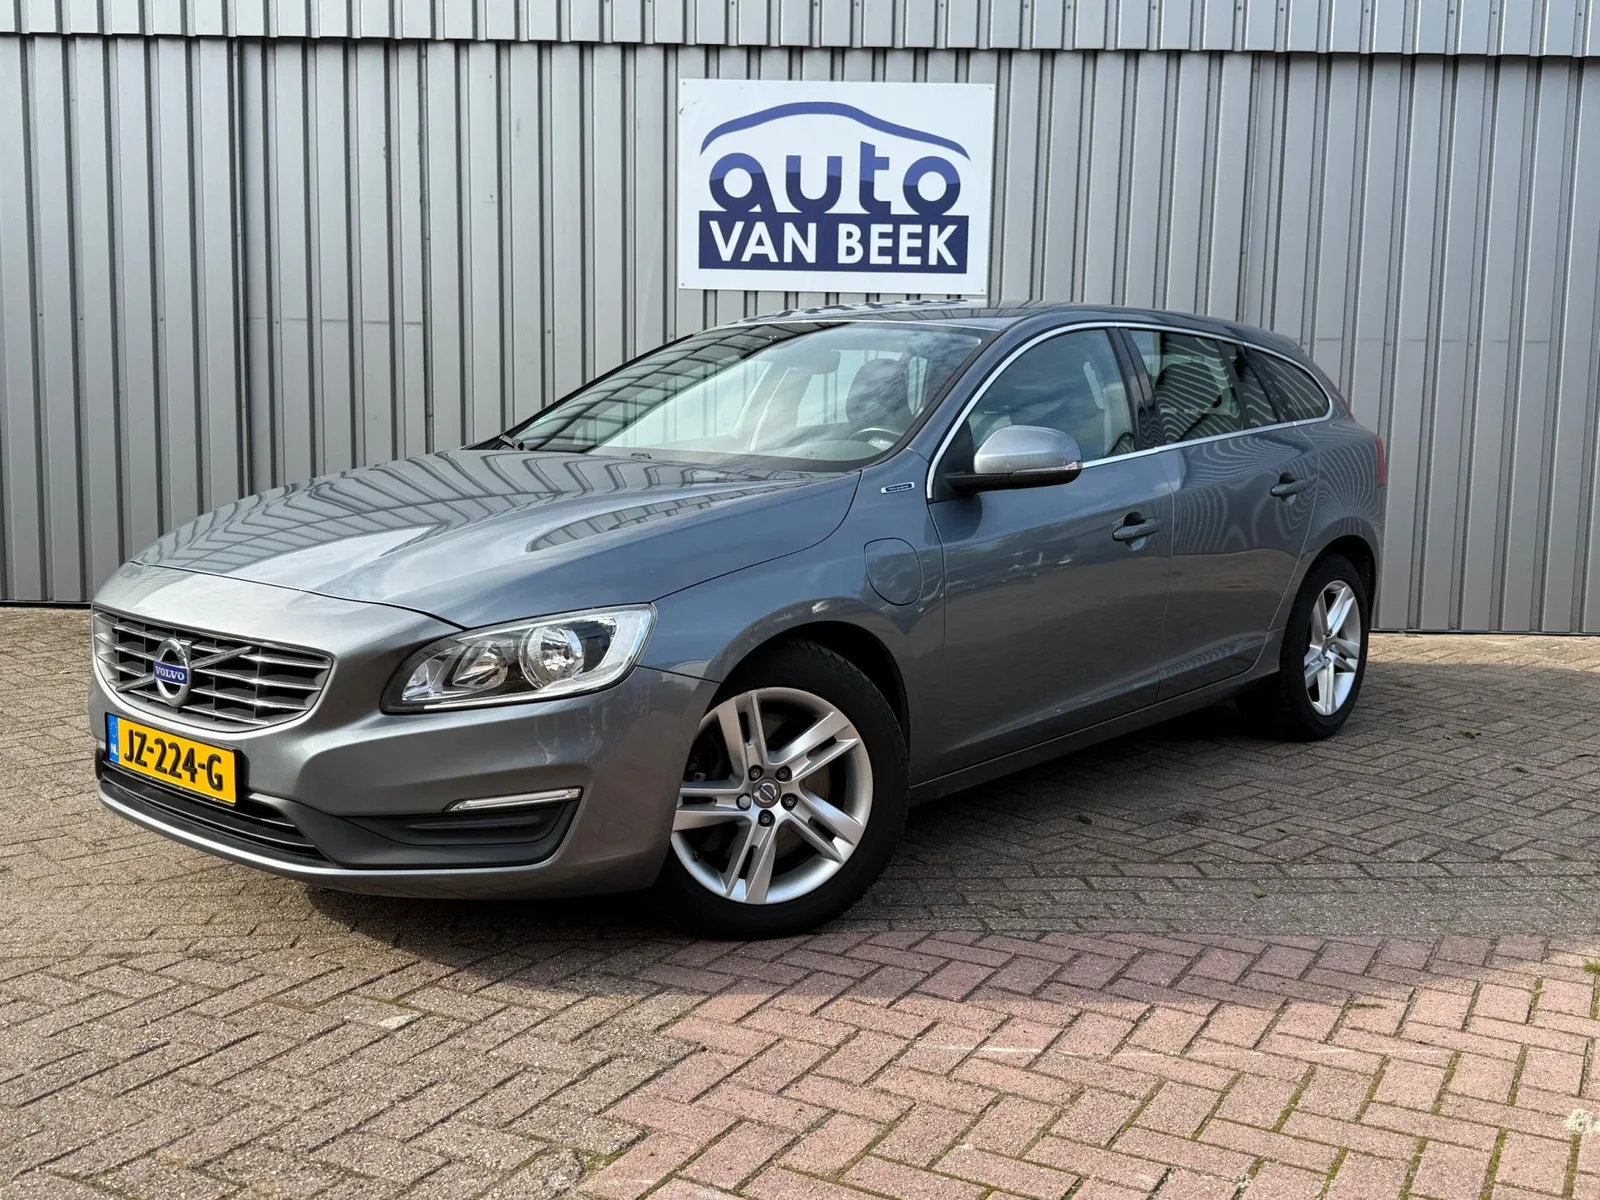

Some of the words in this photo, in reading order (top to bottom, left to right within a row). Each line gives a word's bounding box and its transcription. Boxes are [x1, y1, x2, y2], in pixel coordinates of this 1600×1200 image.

[709, 141, 961, 215] auto
[709, 220, 817, 263] VAN
[837, 223, 958, 266] BEEK
[155, 664, 185, 681] VOLVO
[123, 728, 224, 792] JZ-224-G
